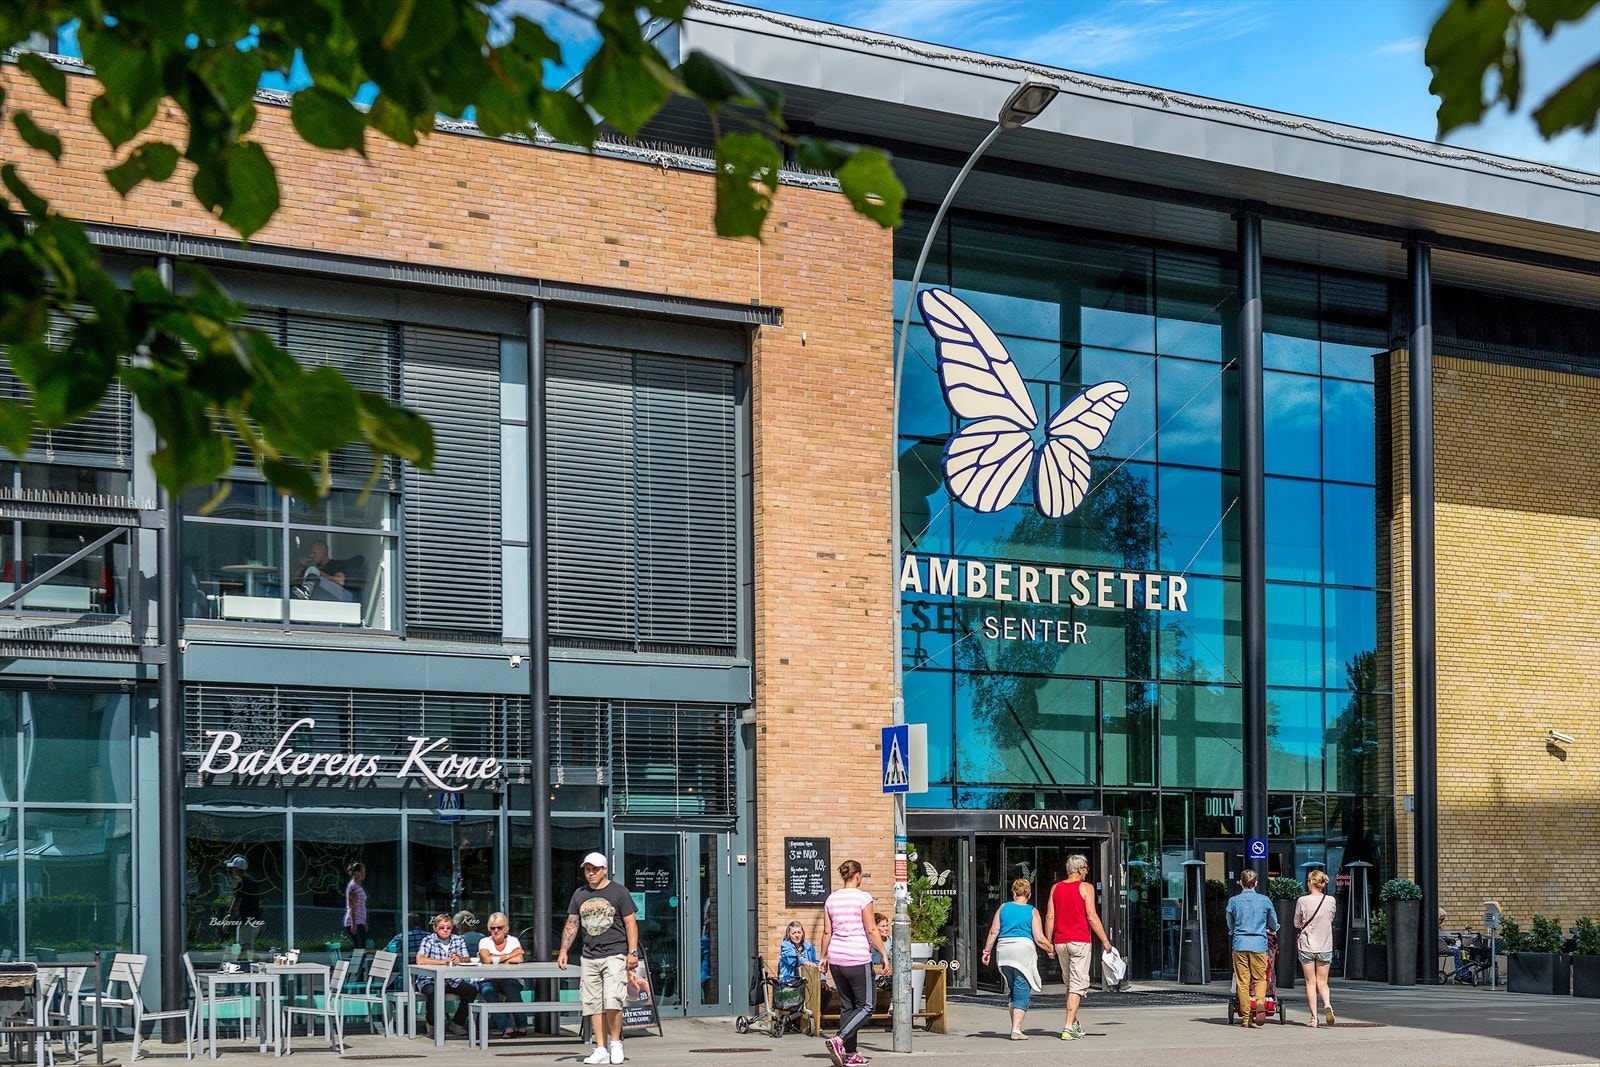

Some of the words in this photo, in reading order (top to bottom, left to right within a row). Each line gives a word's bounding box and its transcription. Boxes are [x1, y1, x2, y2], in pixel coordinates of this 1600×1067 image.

[900, 553, 1189, 612] AMBERTSETER
[983, 616, 1088, 644] SENTER
[198, 717, 381, 777] Bakerens
[396, 735, 502, 792] Kone
[1205, 797, 1235, 817] DOLLY
[999, 814, 1069, 830] INNGANG
[1072, 815, 1087, 830] 21
[789, 850, 796, 860] 3
[208, 914, 243, 928] Bakerens
[244, 916, 266, 928] Kone
[461, 915, 481, 927] Kone
